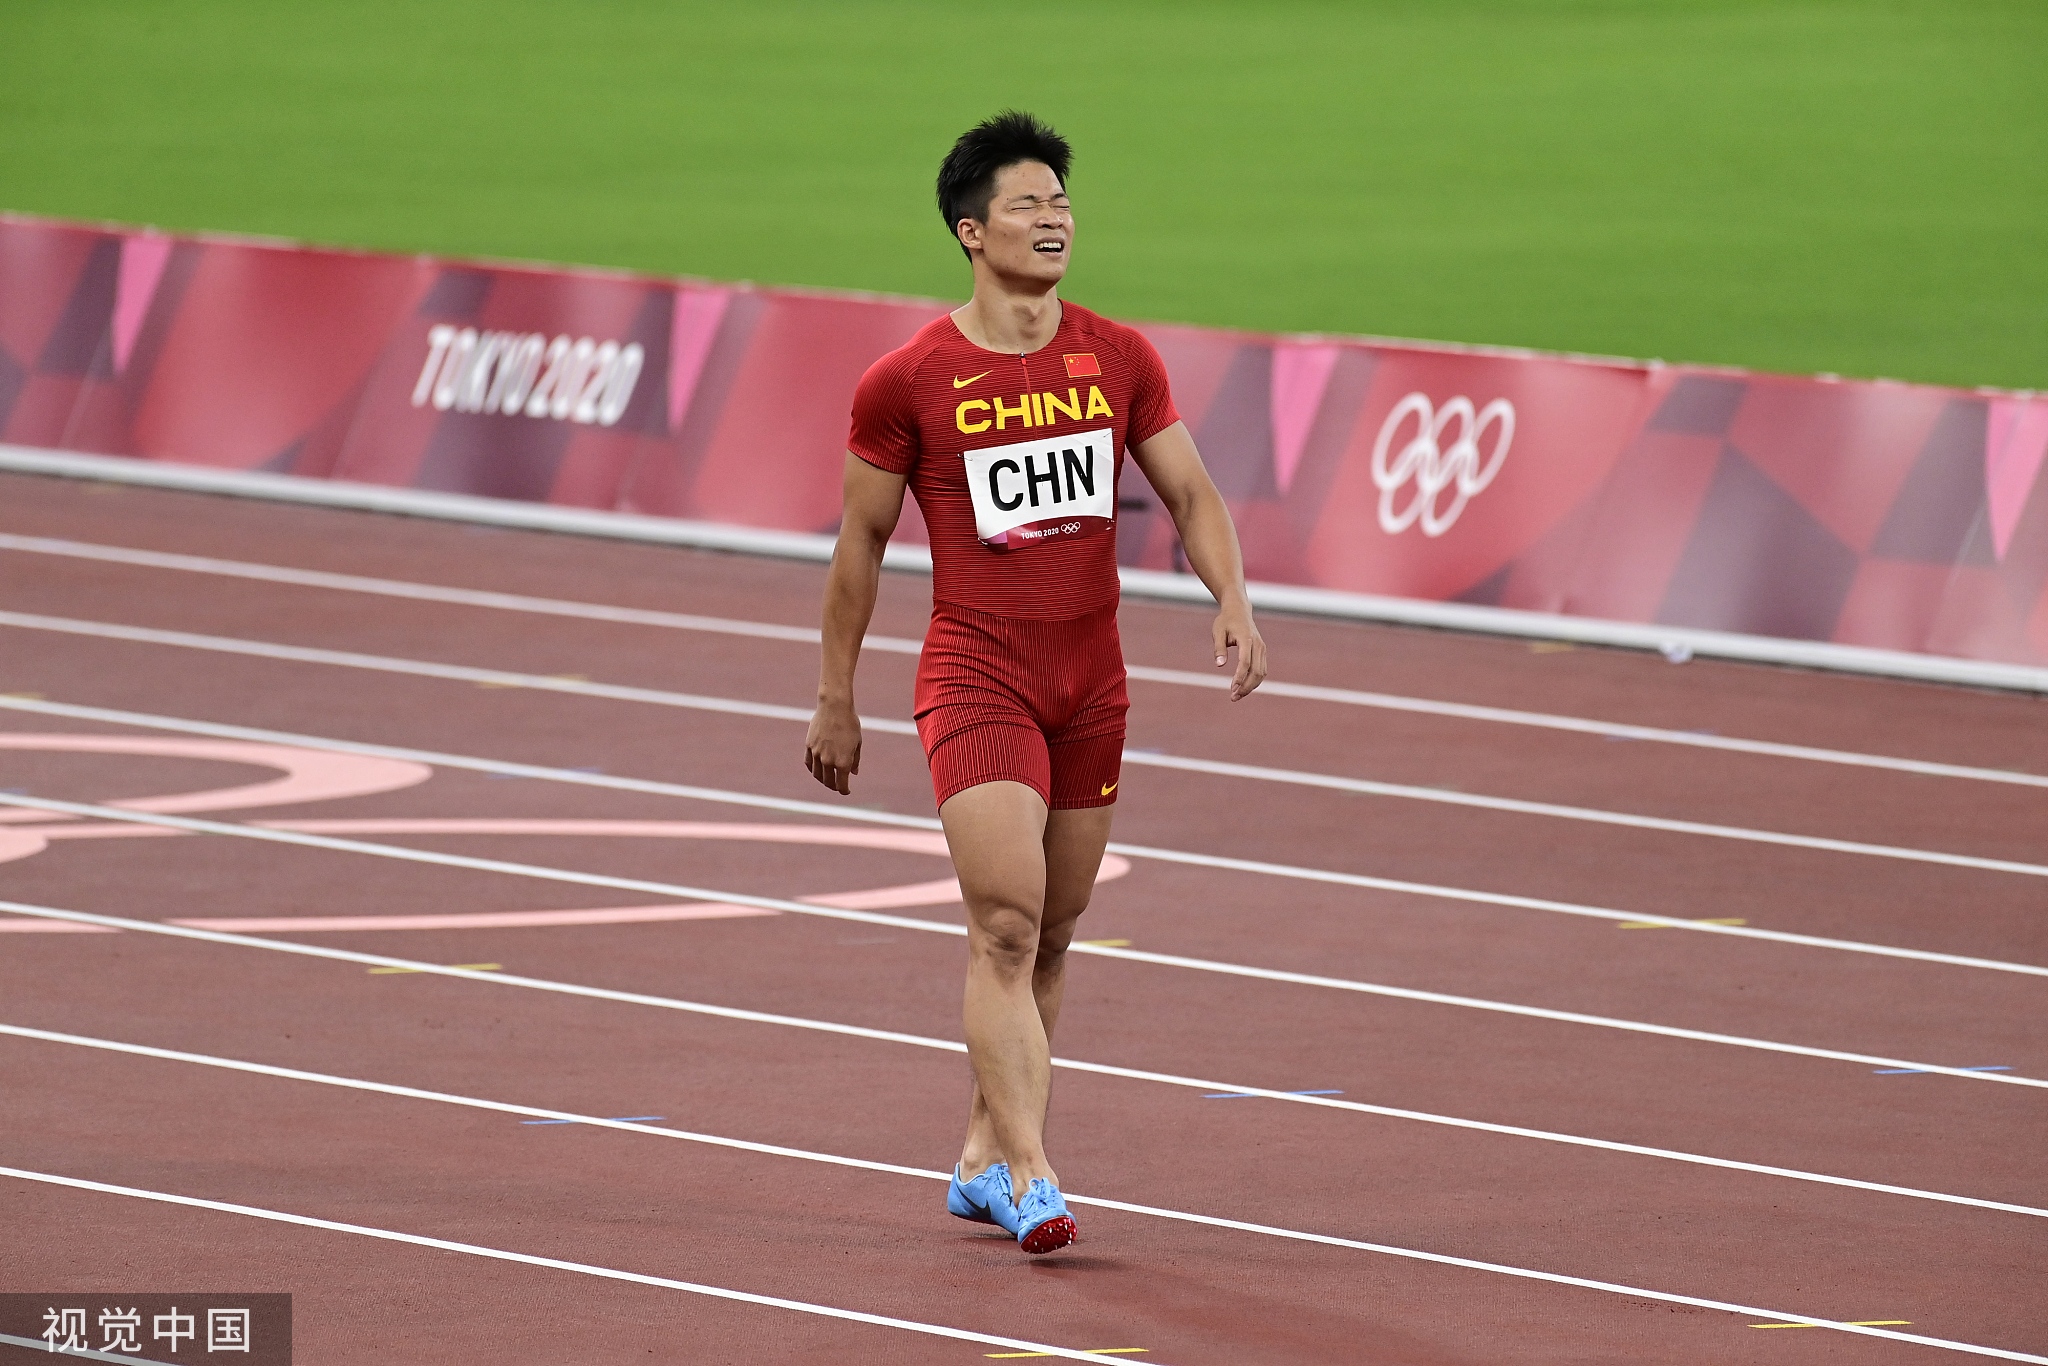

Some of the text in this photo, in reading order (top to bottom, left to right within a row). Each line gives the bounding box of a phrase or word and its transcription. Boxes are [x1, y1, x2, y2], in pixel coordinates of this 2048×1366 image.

[412, 324, 645, 427] TOKYO 2020
[955, 385, 1114, 435] CHINA
[988, 445, 1095, 512] CHN
[1021, 527, 1060, 540] TOKYO 2020
